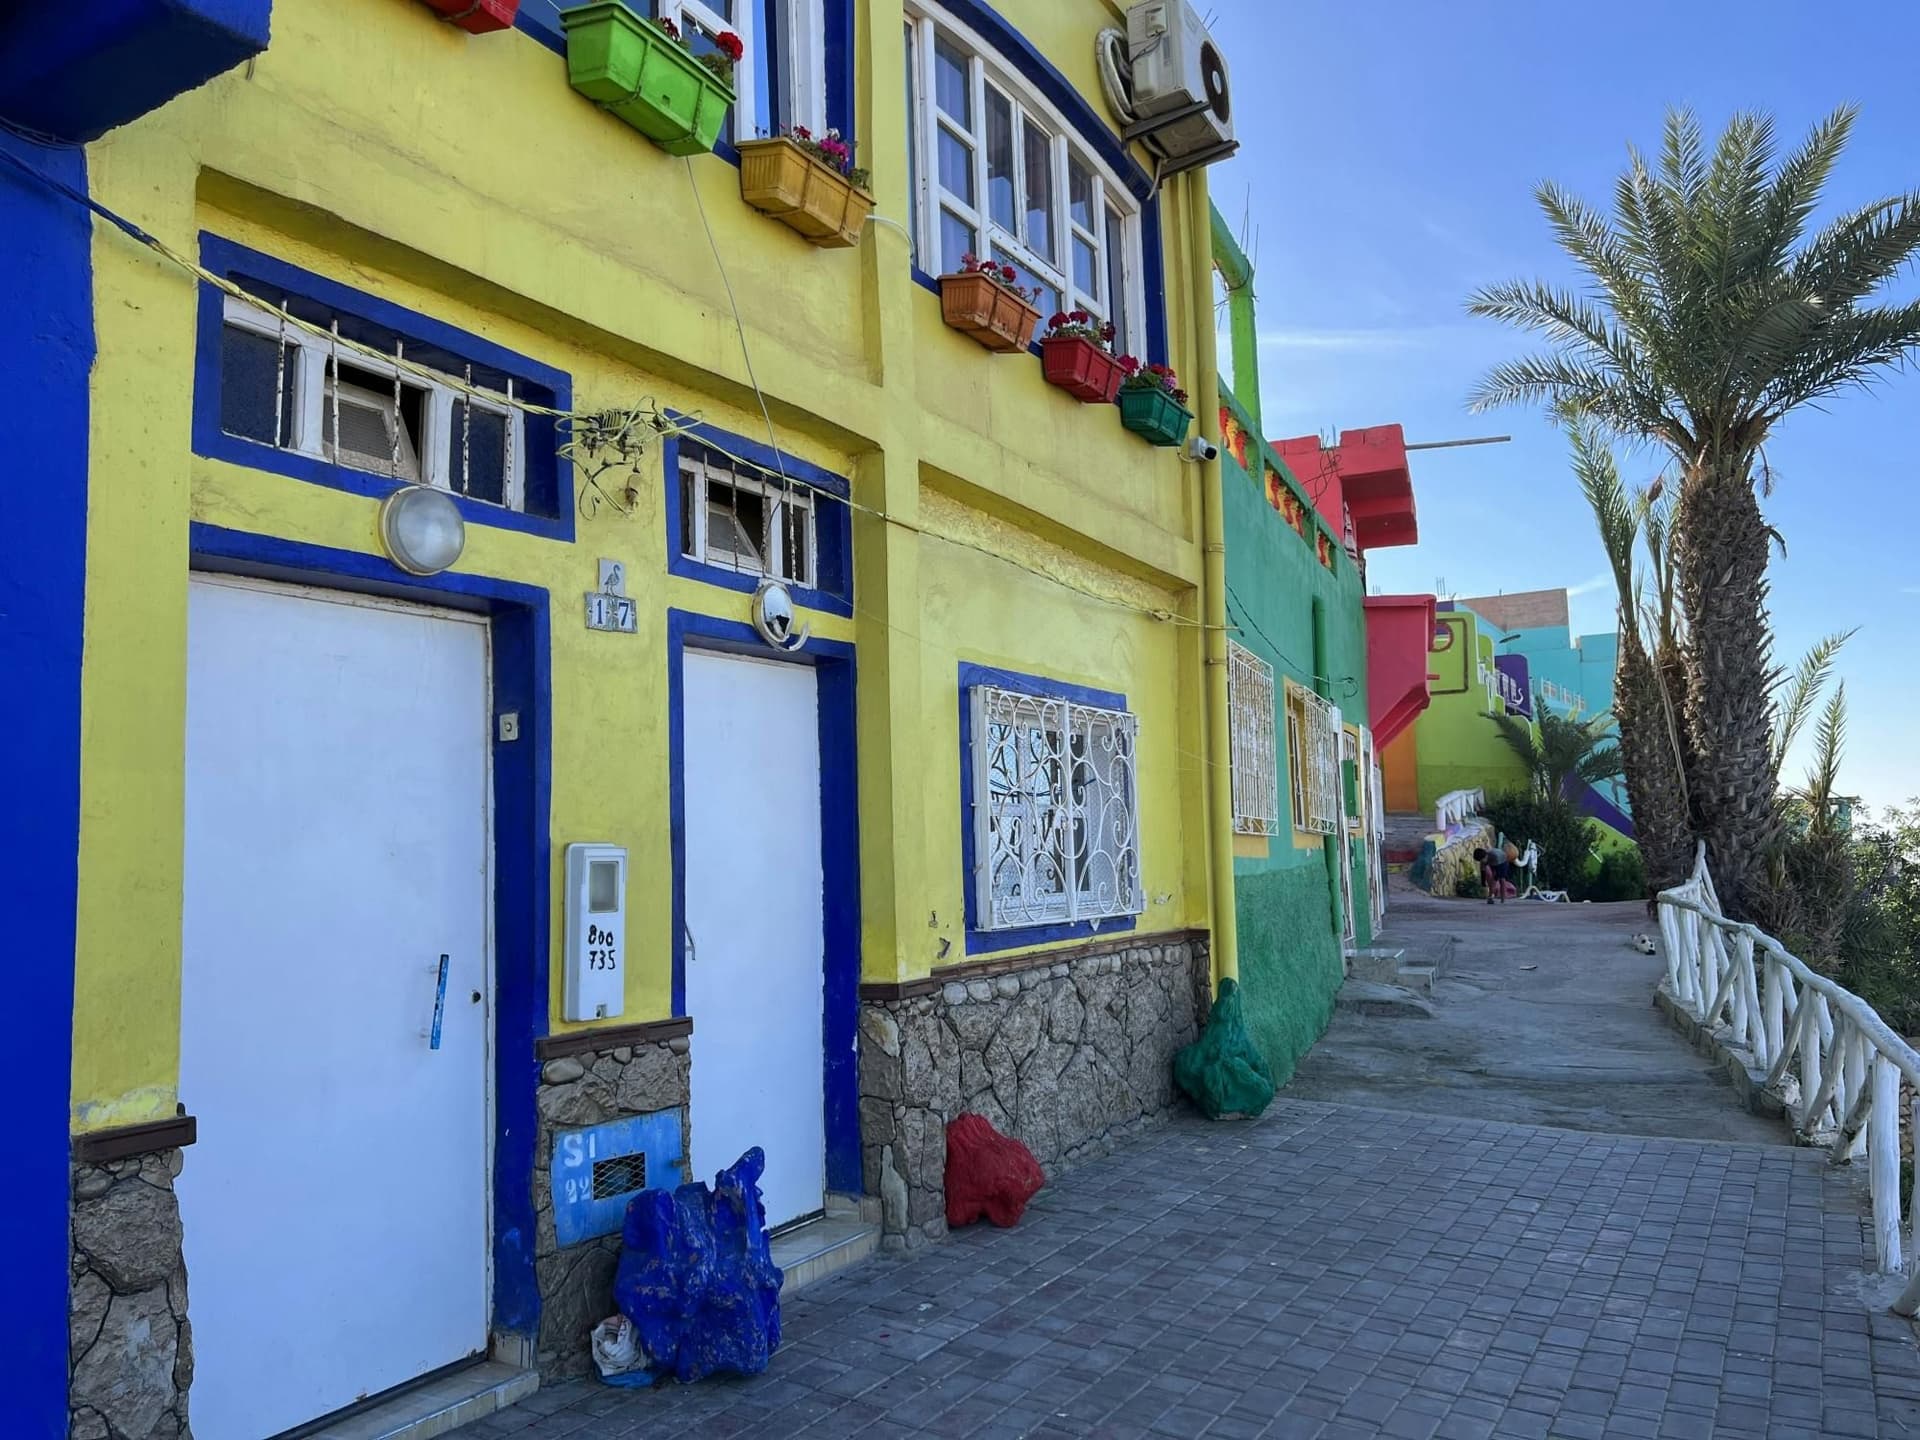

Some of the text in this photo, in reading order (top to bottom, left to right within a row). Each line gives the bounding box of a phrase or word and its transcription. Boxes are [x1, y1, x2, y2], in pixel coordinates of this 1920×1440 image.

[597, 600, 629, 626] 17
[588, 924, 613, 947] 800
[589, 949, 616, 970] 735
